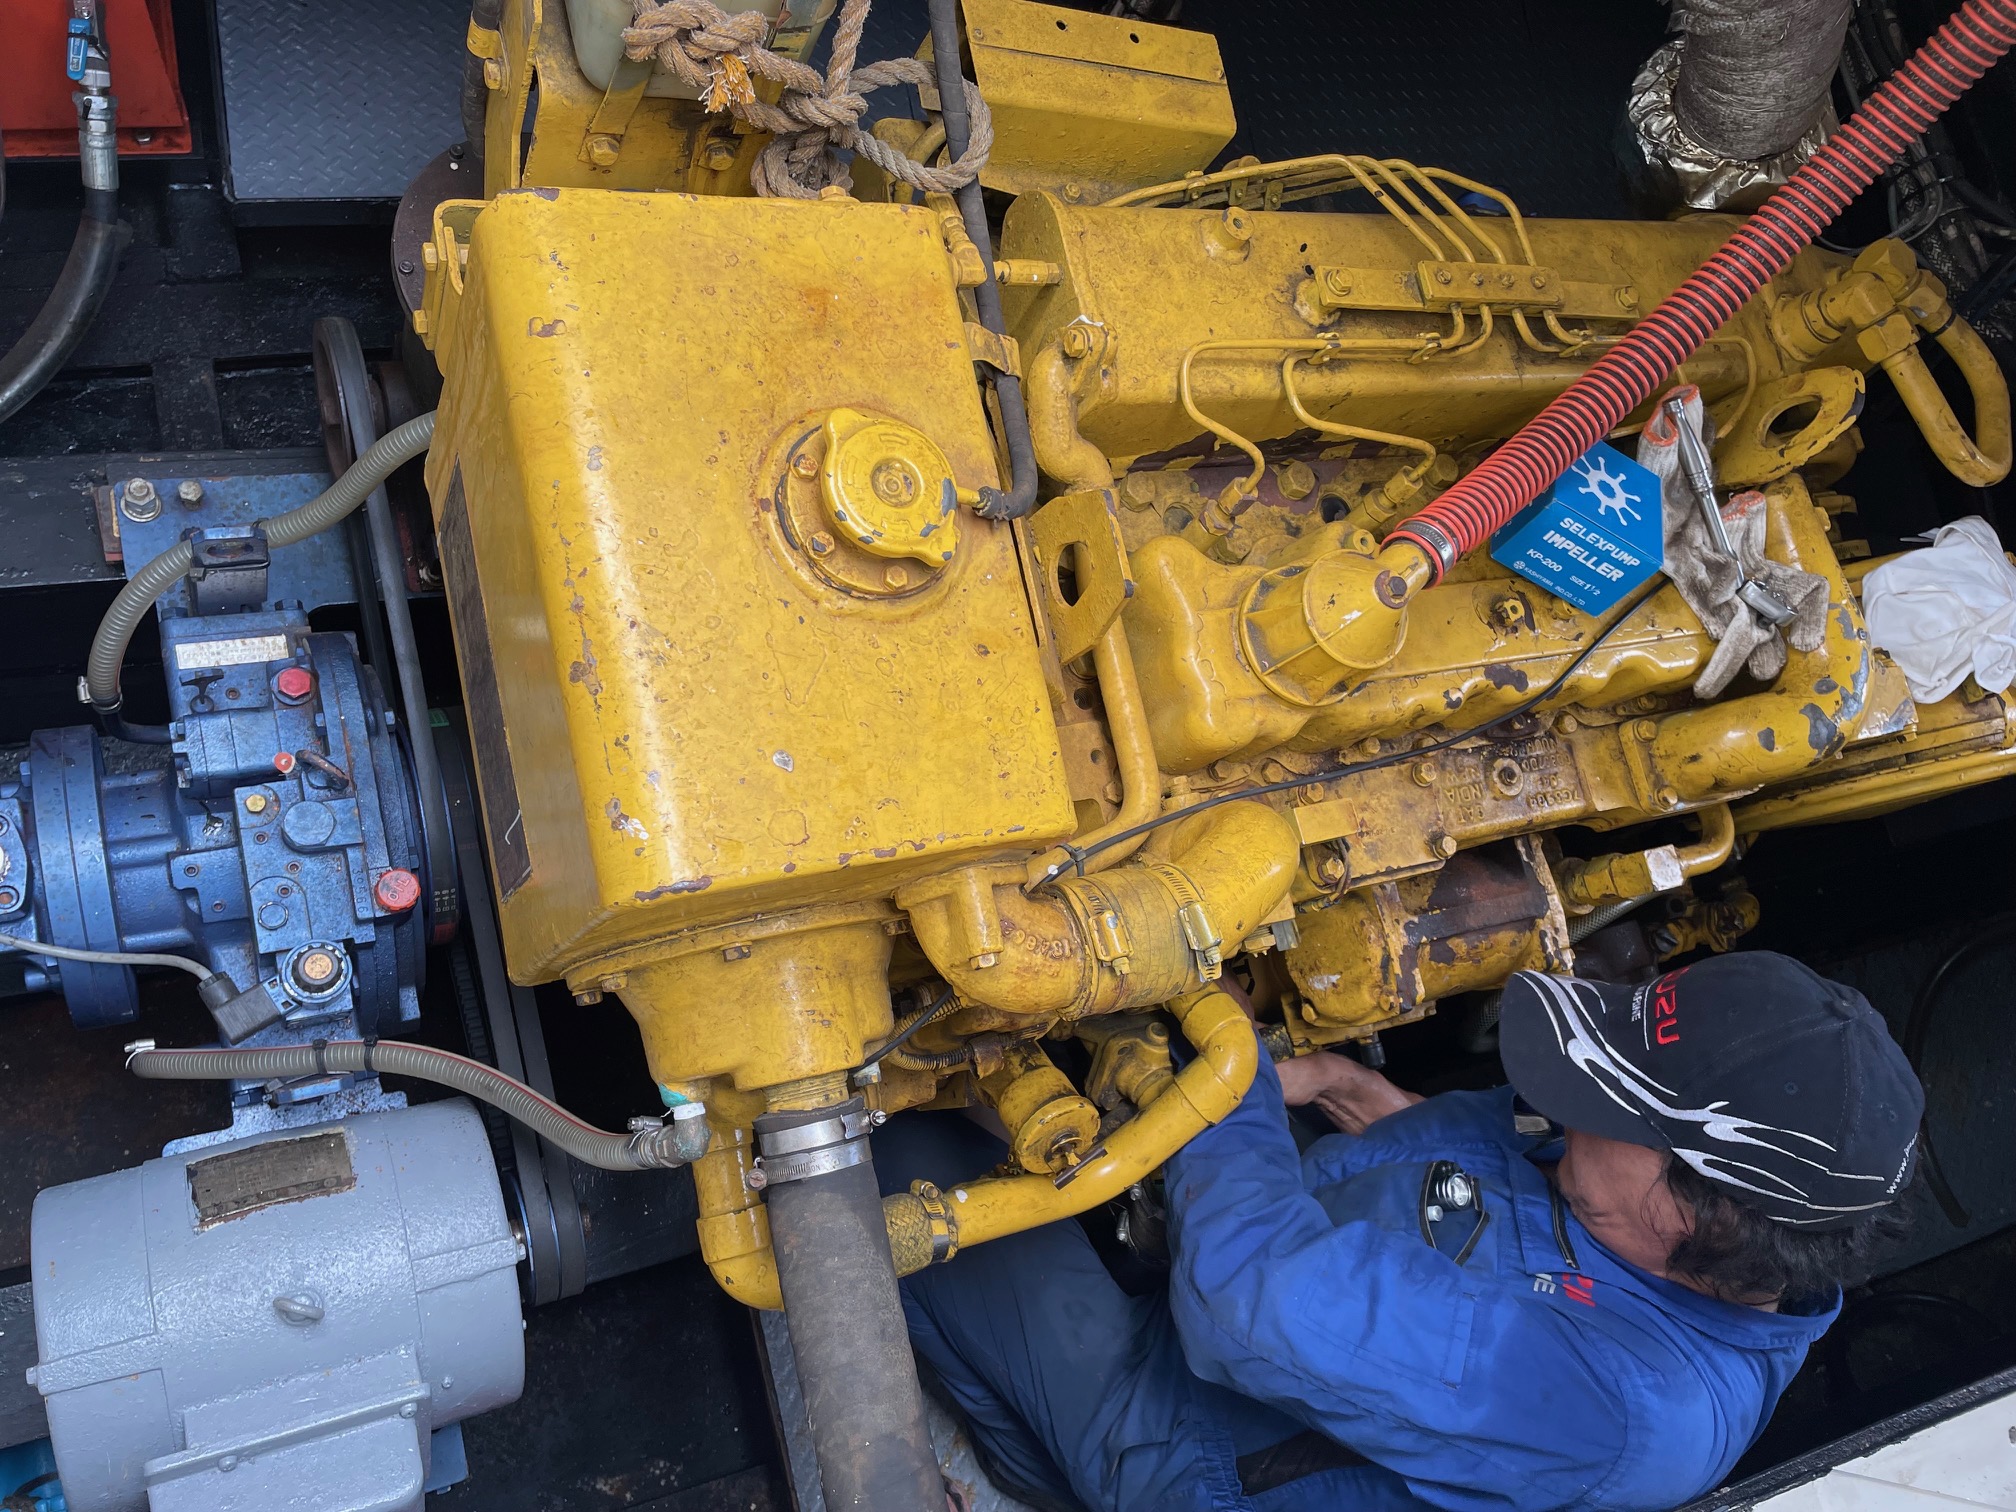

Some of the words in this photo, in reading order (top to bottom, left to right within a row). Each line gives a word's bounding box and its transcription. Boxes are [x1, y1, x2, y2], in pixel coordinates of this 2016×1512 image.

[1559, 517, 1641, 566] SELEXPUMP
[1526, 548, 1563, 572] KP-200
[1542, 529, 1625, 582] IMPELLER
[1523, 566, 1554, 587] KASHIYAMA
[1569, 575, 1586, 588] SIZE
[388, 879, 411, 901] OIL
